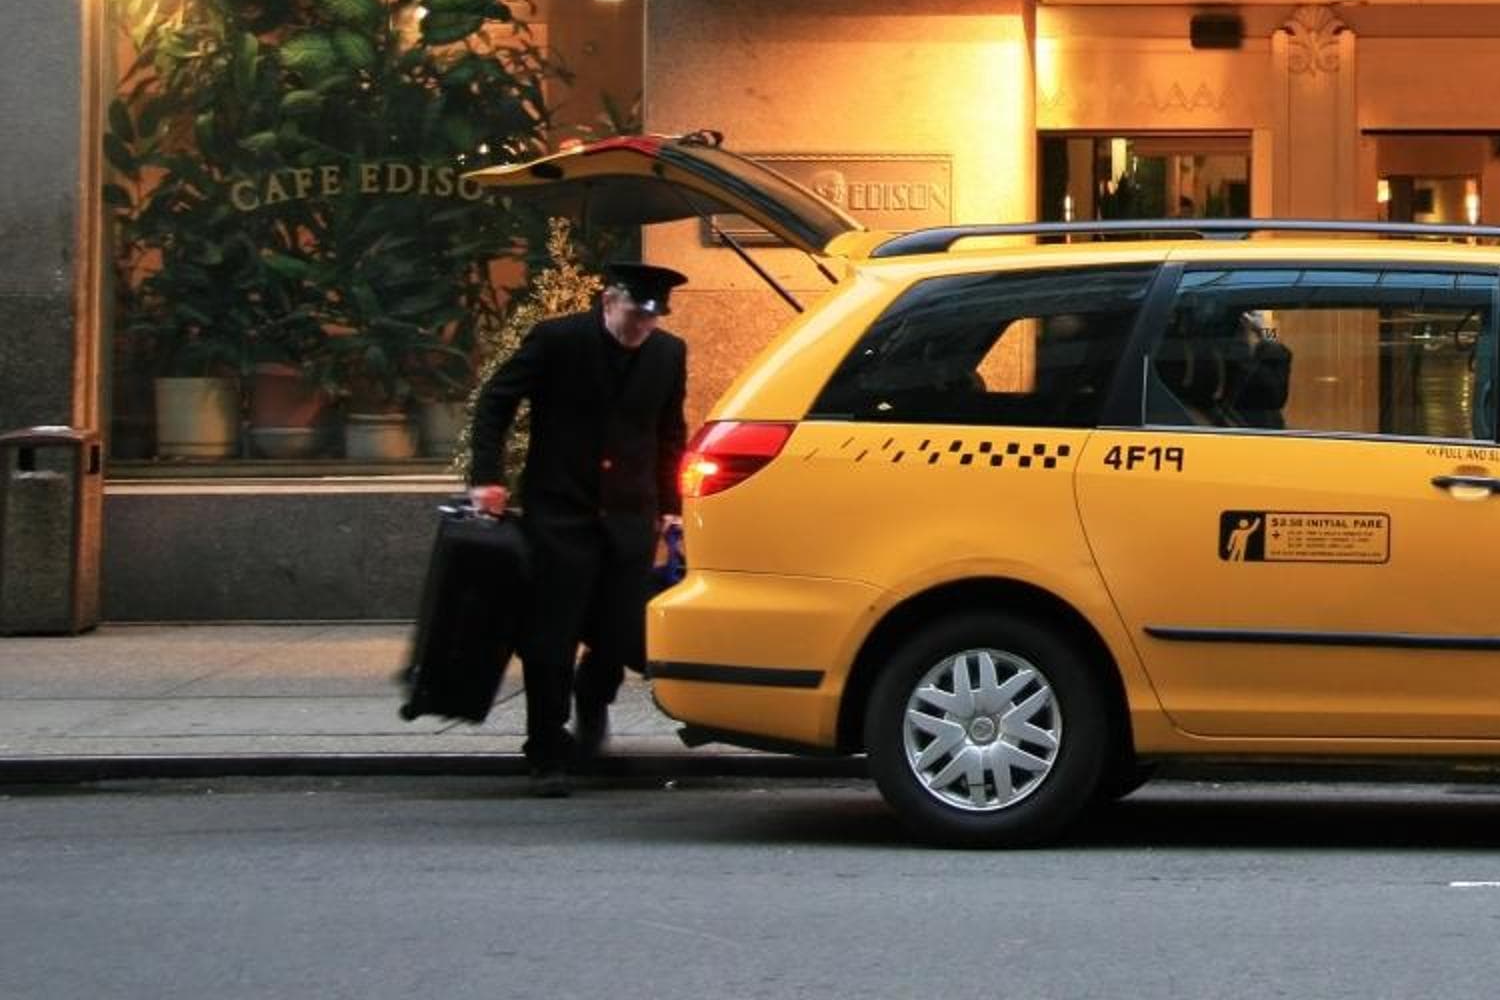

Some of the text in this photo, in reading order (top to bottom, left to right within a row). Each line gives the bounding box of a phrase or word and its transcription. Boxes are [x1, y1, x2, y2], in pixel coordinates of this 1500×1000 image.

[231, 163, 512, 212] CAFE EDISO
[1103, 445, 1184, 472] 4F19
[1306, 518, 1347, 529] INITIAL
[1352, 519, 1384, 529] FARE
